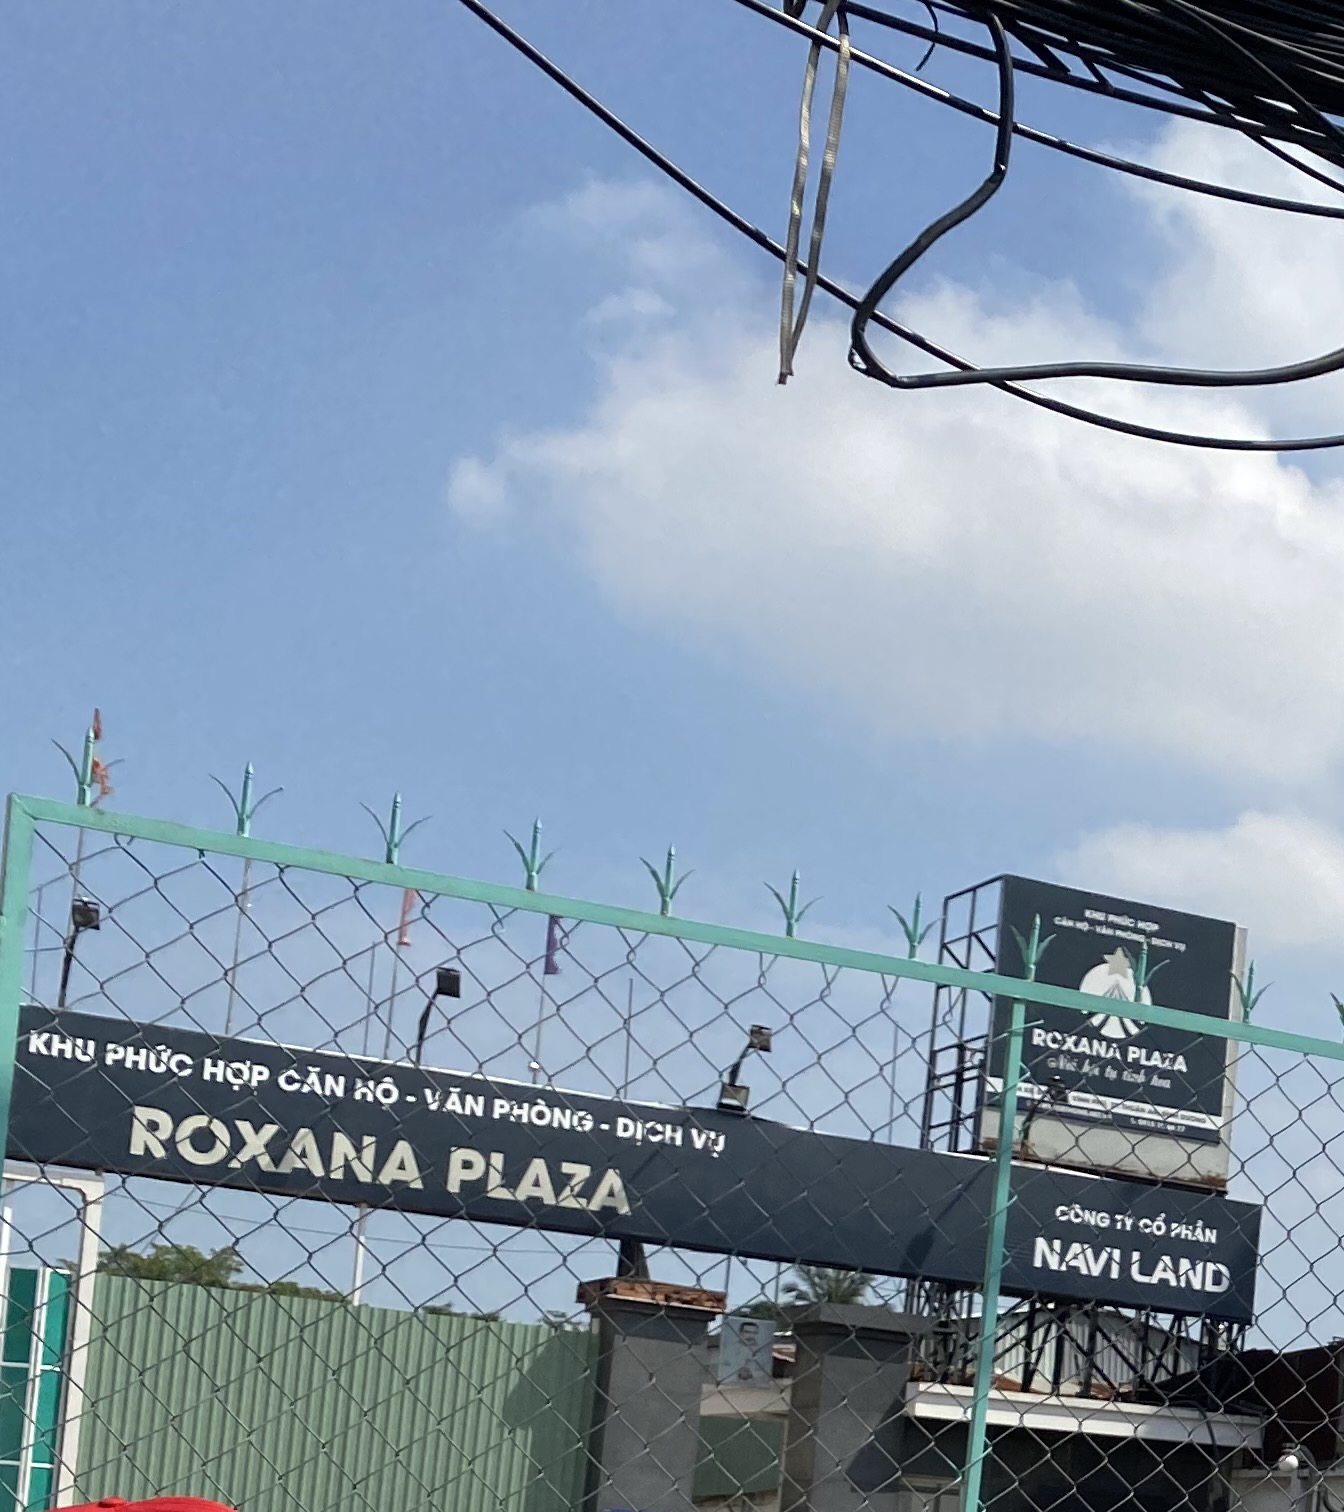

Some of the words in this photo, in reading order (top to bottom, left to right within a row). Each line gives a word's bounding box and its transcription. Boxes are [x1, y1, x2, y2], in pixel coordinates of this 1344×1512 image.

[1032, 1028, 1121, 1061] ROXANA
[1128, 1046, 1188, 1073] PLAZA
[29, 1029, 95, 1062] KHU
[105, 1042, 193, 1077] PHỨC
[203, 1057, 270, 1092] HỢP
[278, 1066, 346, 1098] CĂN
[354, 1077, 399, 1110] HỘ
[423, 1087, 484, 1118] VĂN
[492, 1098, 594, 1133] PHÒNG
[617, 1116, 683, 1146] DỊCH
[690, 1127, 726, 1159] VỤ
[129, 1105, 424, 1190] ROXANA
[447, 1146, 632, 1216] PLAZA
[1055, 1203, 1110, 1229] CÔNG
[1115, 1213, 1133, 1232] TY
[1138, 1212, 1166, 1236] CỔ
[1170, 1220, 1217, 1244] PHẦN
[1032, 1236, 1121, 1280] NAVI
[1131, 1251, 1231, 1293] LAND
